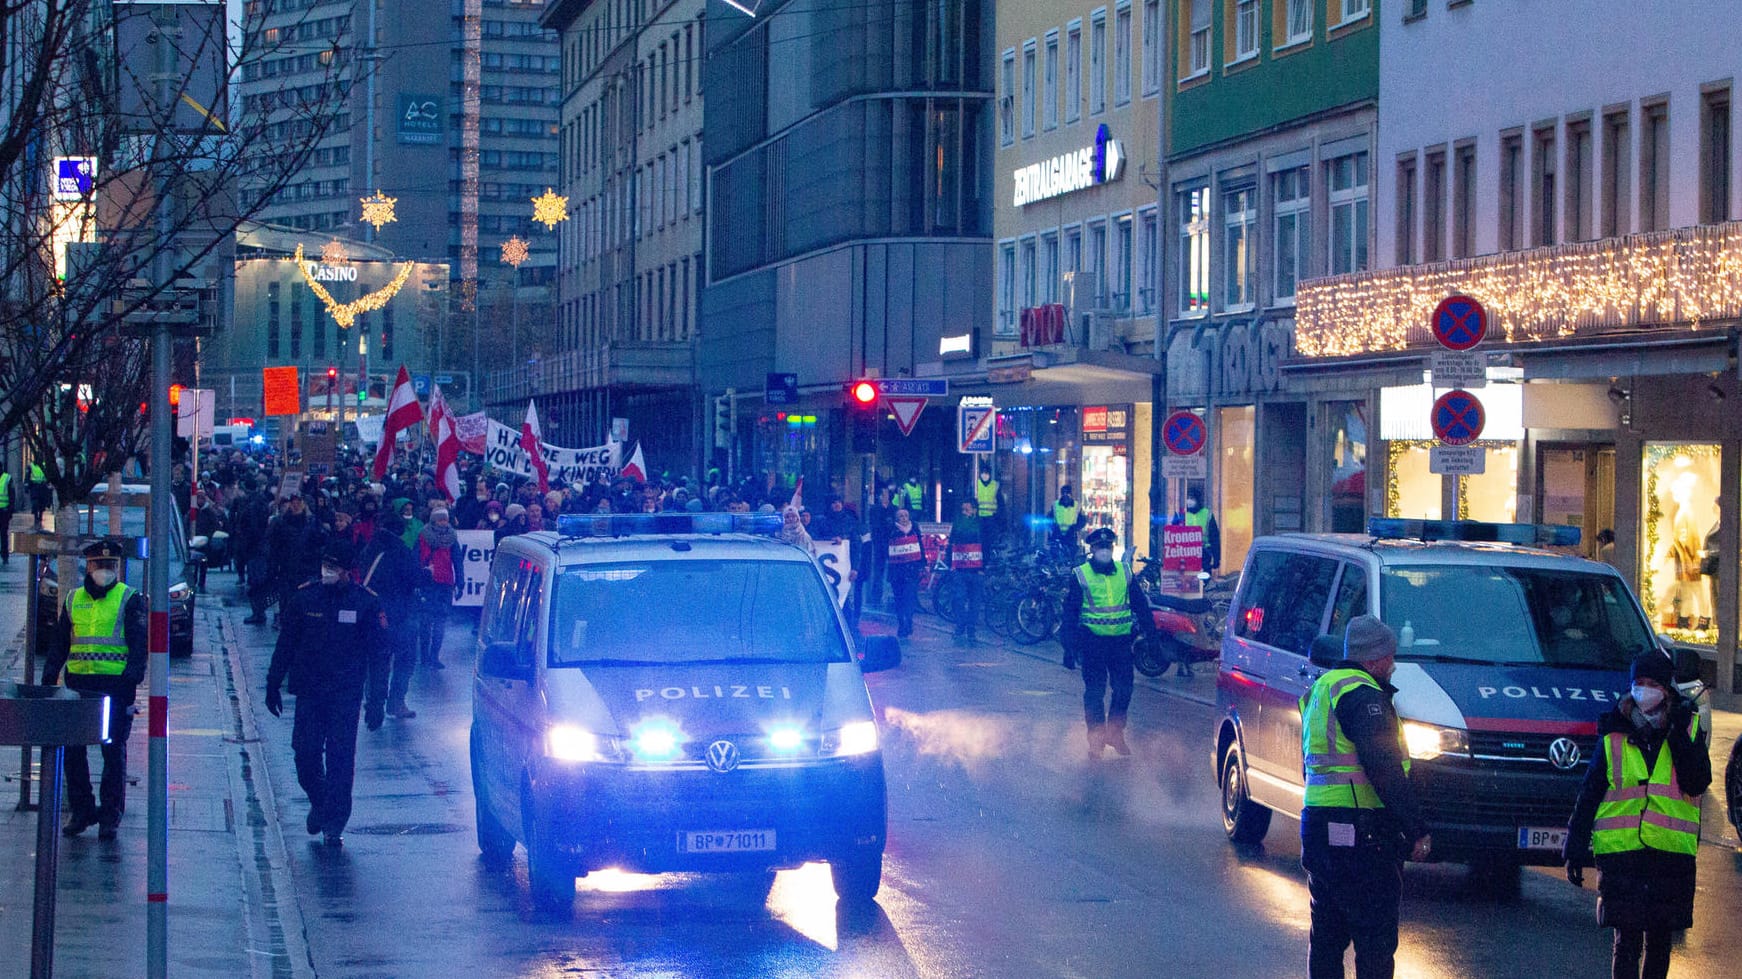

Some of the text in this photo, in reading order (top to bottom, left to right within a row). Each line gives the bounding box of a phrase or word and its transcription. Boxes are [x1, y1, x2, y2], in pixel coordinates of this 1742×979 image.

[307, 263, 358, 281] CASINO
[486, 446, 517, 469] VON
[575, 449, 610, 465] WEG
[1164, 530, 1202, 545] Kronen
[1165, 545, 1202, 558] Zeitung
[635, 685, 792, 702] POLIZEI
[695, 832, 766, 850] BP 71011
[1532, 831, 1550, 846] BP
